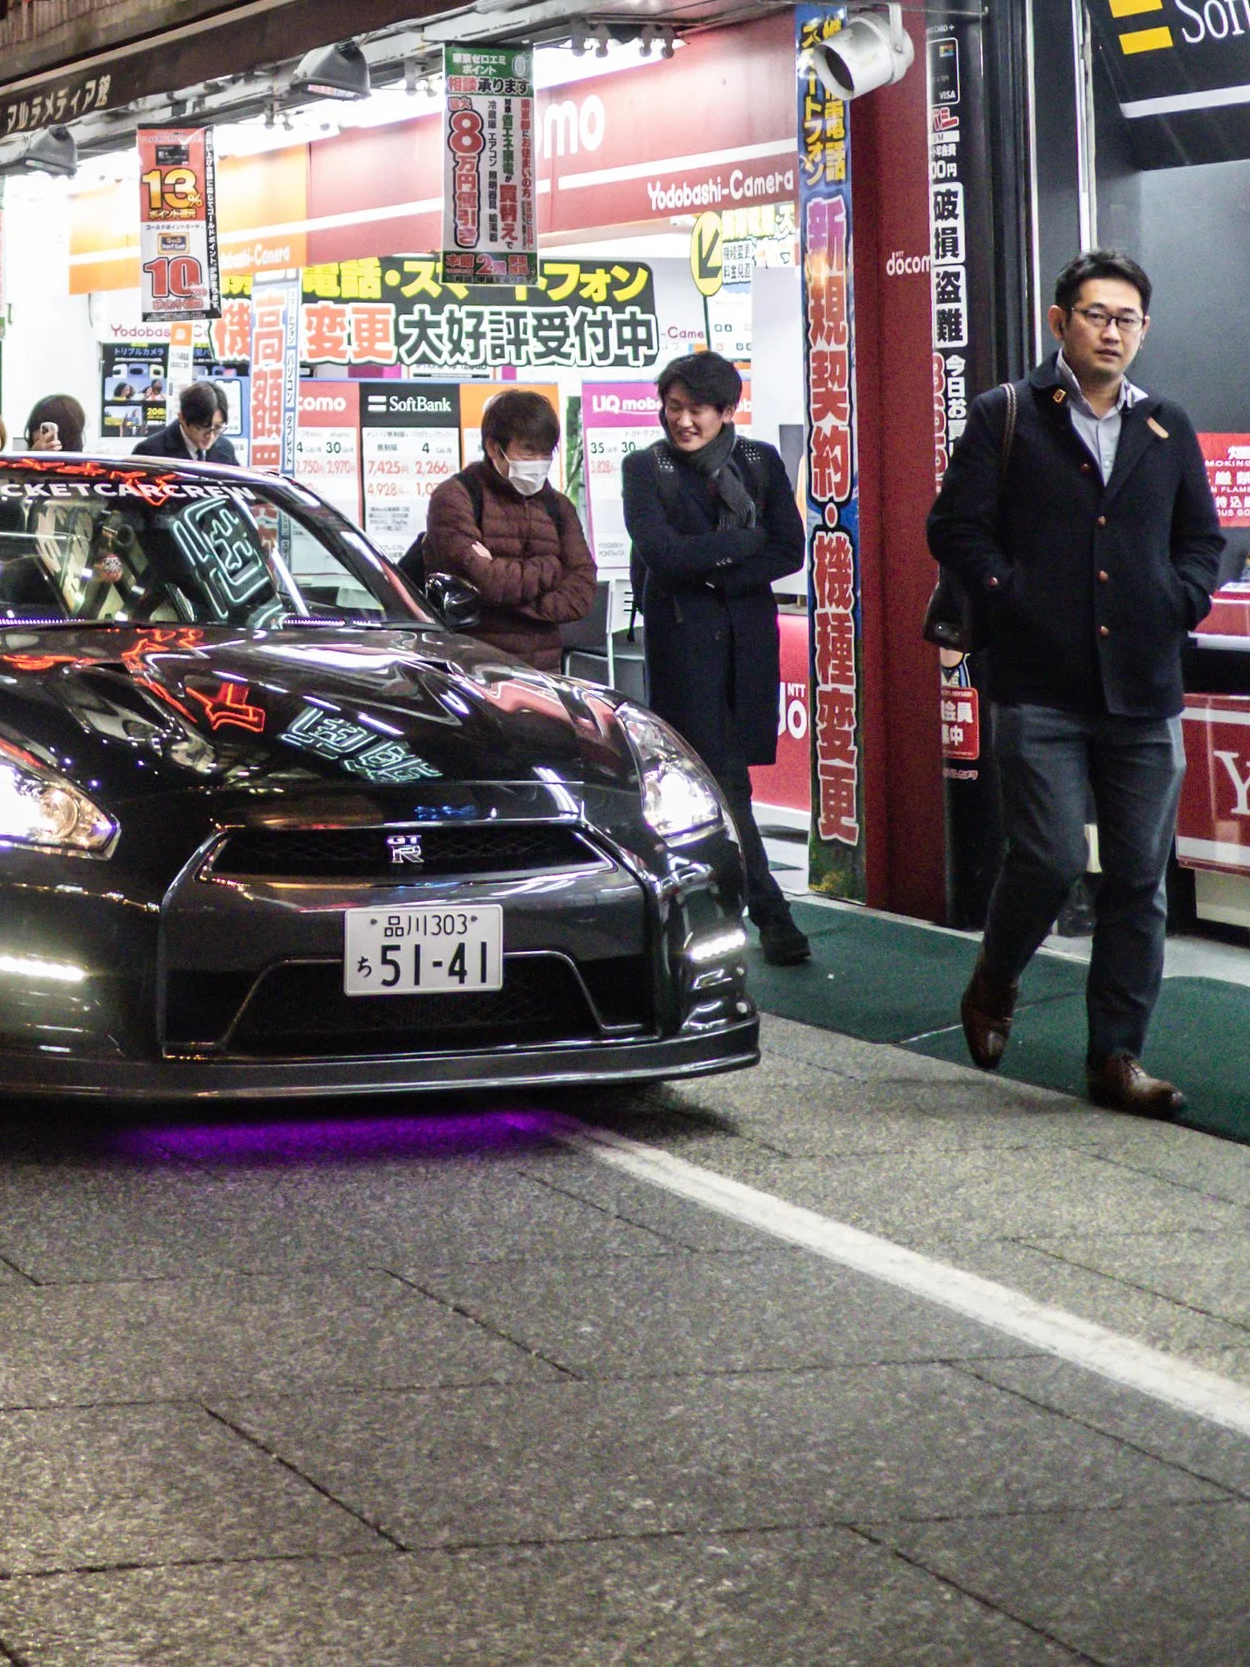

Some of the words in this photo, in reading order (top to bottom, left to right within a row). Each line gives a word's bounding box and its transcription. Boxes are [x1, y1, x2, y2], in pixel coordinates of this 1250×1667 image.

[452, 52, 507, 66] 東京ゼロエミ
[462, 65, 497, 76] ポイント
[448, 75, 530, 94] 相談承ります
[6, 74, 112, 133] マルチメディア館
[939, 91, 956, 100] VISA
[448, 110, 485, 248] 8万円値引き
[142, 168, 203, 210] 13%
[647, 168, 795, 211] Yodobashi-Camera
[934, 188, 961, 259] 破損
[935, 272, 964, 343] 盗難
[210, 300, 660, 370] 機変更大好評受付中
[113, 347, 165, 356] トリプルカメラ
[389, 395, 452, 414] SoftBank
[592, 394, 619, 413] UQ
[421, 442, 430, 454] 4
[805, 197, 860, 847] 新規契約・機種変更
[787, 684, 807, 698] NTT
[386, 834, 423, 845] GT
[391, 844, 424, 863] R
[380, 940, 489, 987] 51-41
